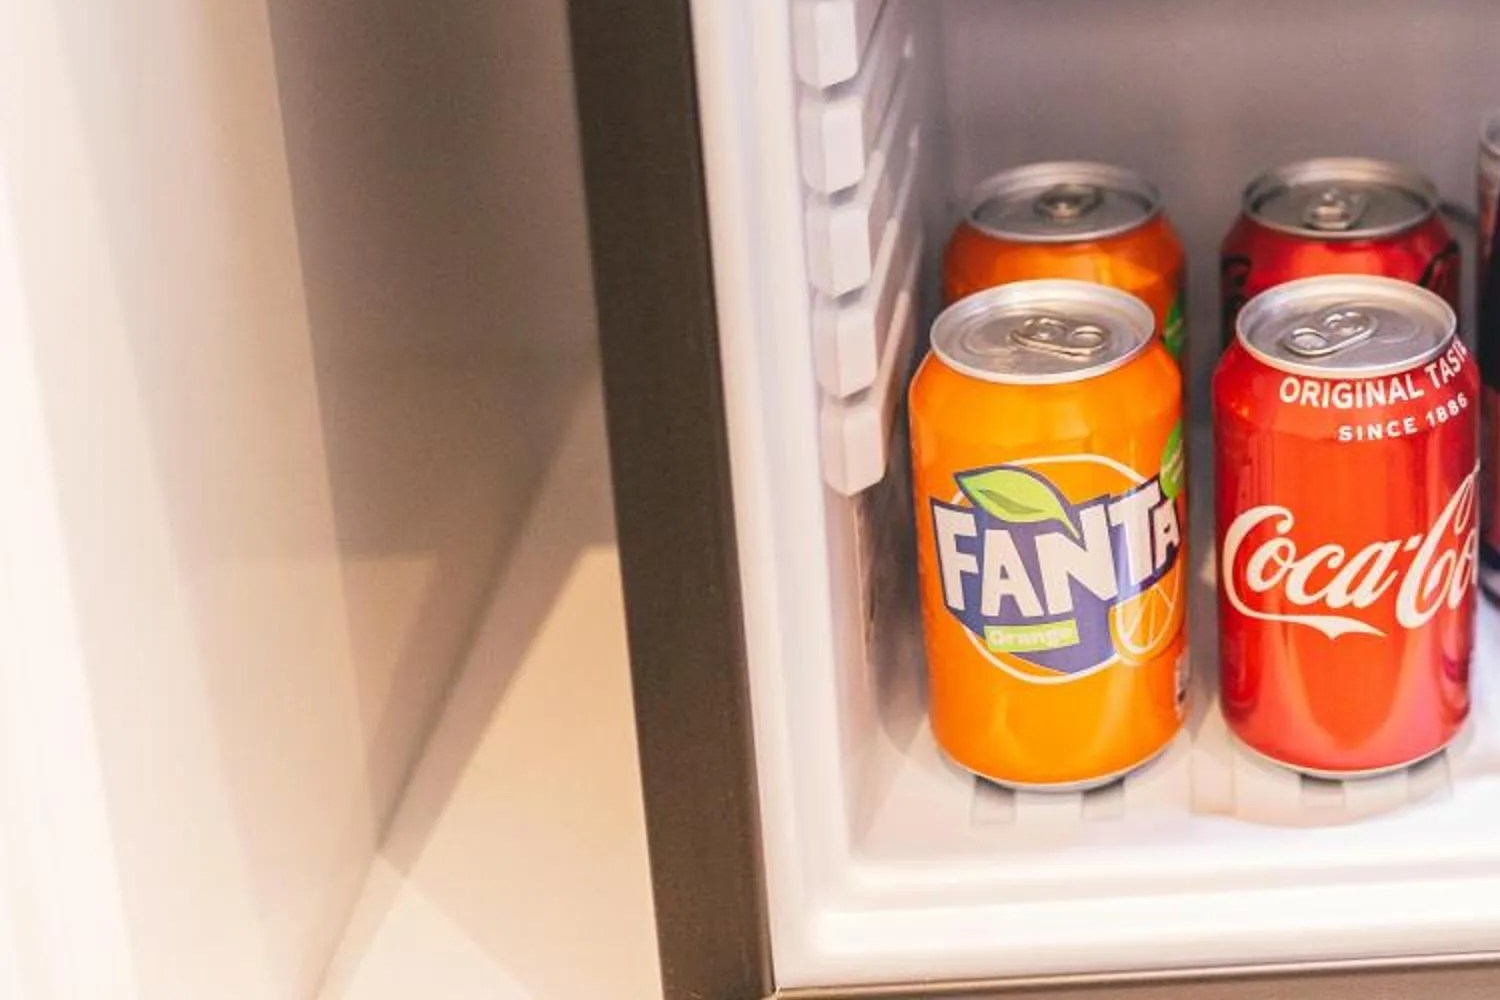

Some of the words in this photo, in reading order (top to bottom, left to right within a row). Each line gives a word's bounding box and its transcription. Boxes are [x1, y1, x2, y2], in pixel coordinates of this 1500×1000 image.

[1279, 374, 1425, 409] ORIGINAL
[1338, 416, 1418, 441] SINCE
[1426, 391, 1468, 428] 1886
[932, 480, 1180, 617] FANTA
[1223, 458, 1479, 640] Coca-Co
